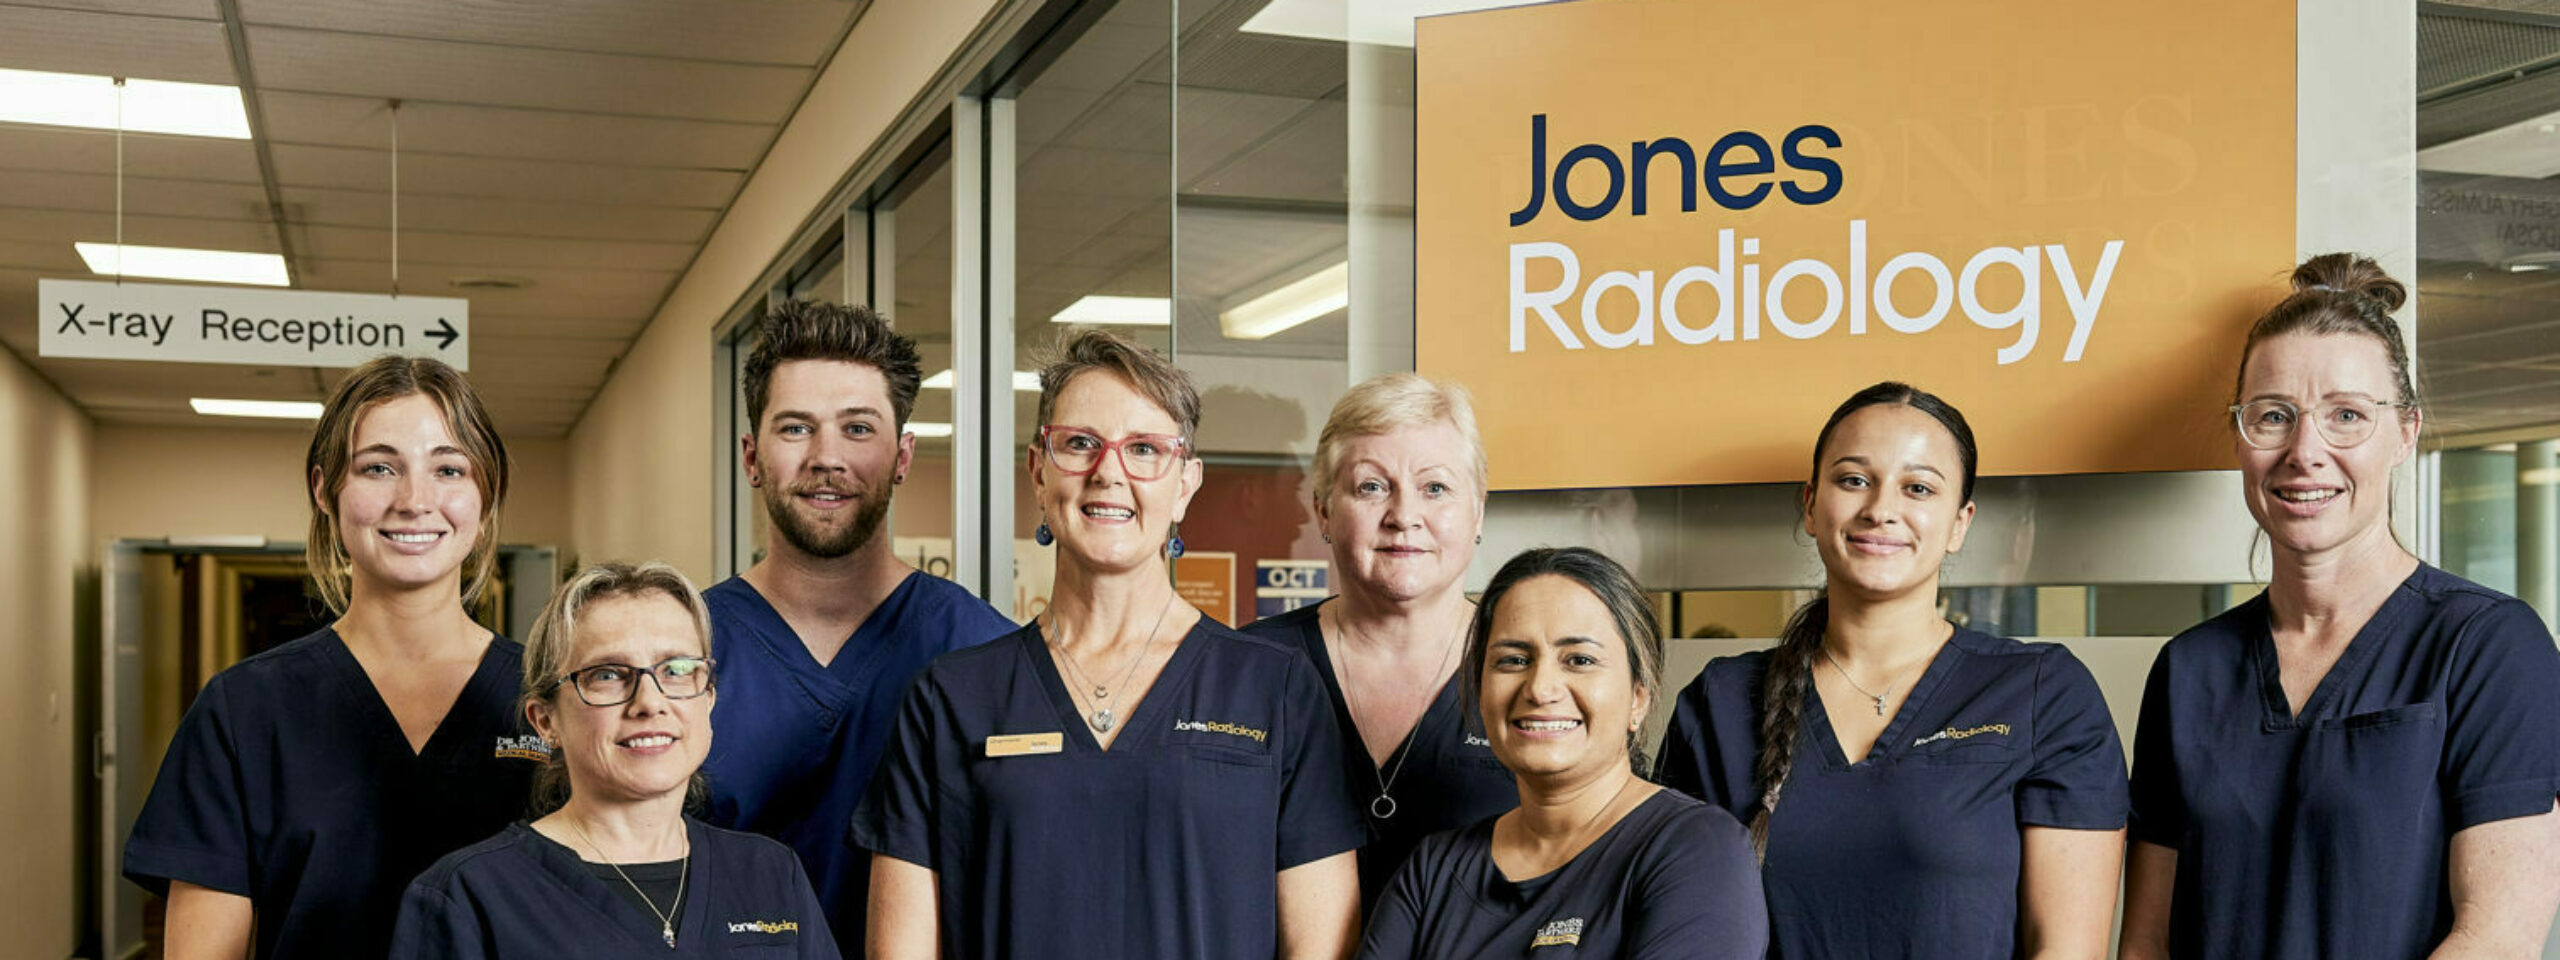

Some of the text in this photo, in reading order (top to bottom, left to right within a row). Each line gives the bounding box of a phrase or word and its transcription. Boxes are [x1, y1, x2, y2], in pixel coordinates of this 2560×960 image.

[1510, 113, 1843, 228] Jones
[58, 302, 405, 352] X-ray Reception
[1509, 218, 2125, 365] Radiology
[1267, 566, 1316, 588] OCT
